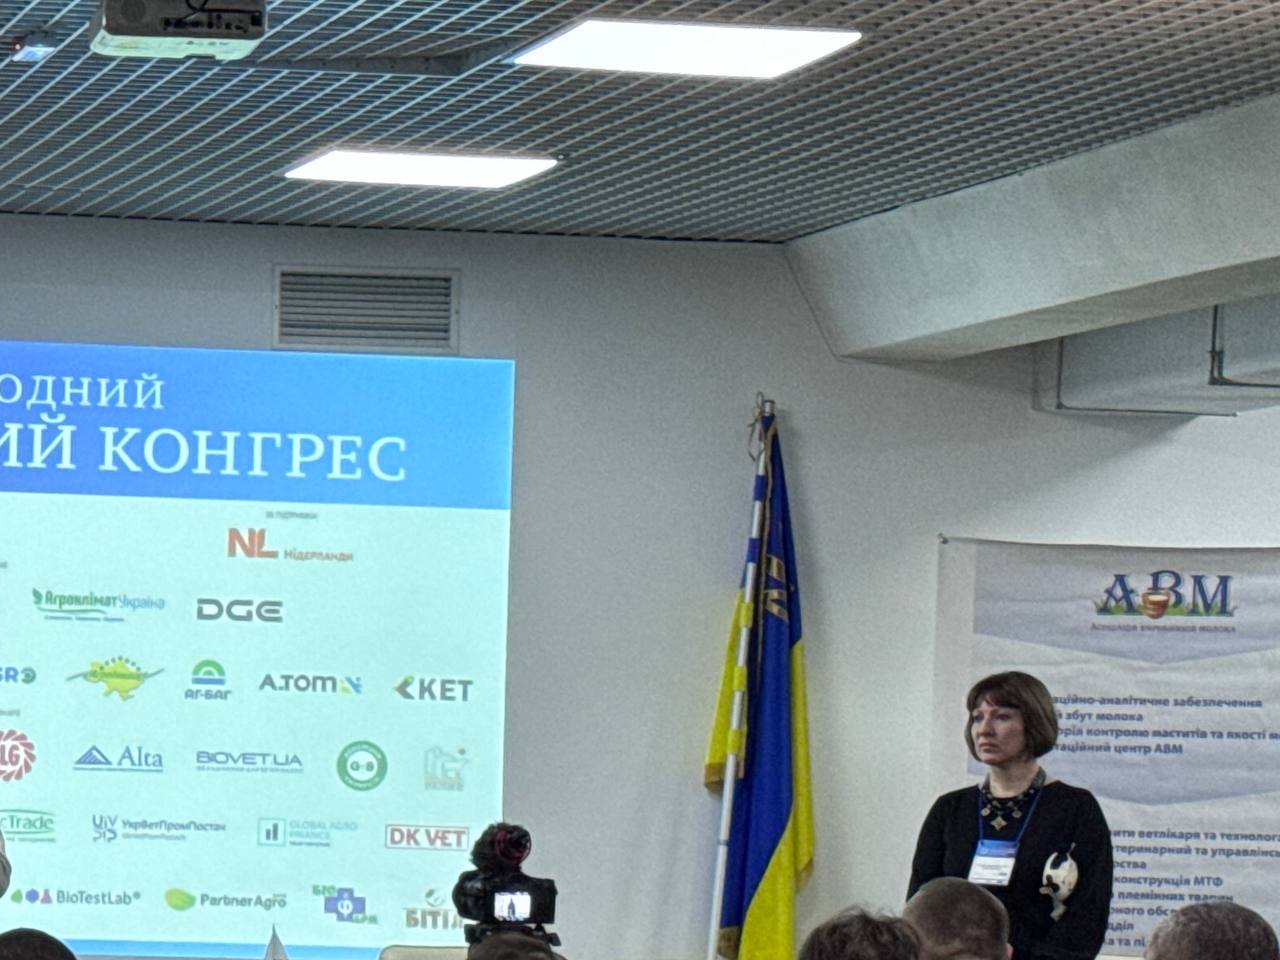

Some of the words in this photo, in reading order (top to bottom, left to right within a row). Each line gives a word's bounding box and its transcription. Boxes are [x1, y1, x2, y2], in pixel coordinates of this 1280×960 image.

[99, 426, 407, 482] КОНГРЕС
[227, 528, 278, 558] NL
[196, 598, 284, 623] DGE
[1173, 697, 1263, 708] забезпечення
[1065, 709, 1092, 723] збут
[1096, 713, 1143, 722] молока
[1086, 729, 1149, 739] контролю
[1152, 728, 1207, 739] маститів
[1211, 731, 1223, 739] та
[1114, 745, 1152, 755] центр
[1154, 744, 1183, 754] АВМ
[117, 746, 163, 768] Alta
[389, 827, 421, 846] DK
[1138, 828, 1201, 841] ветлікаря
[1204, 832, 1216, 840] та
[1112, 845, 1192, 856] теринарний
[1195, 847, 1208, 856] та
[1193, 875, 1224, 887] МТФ
